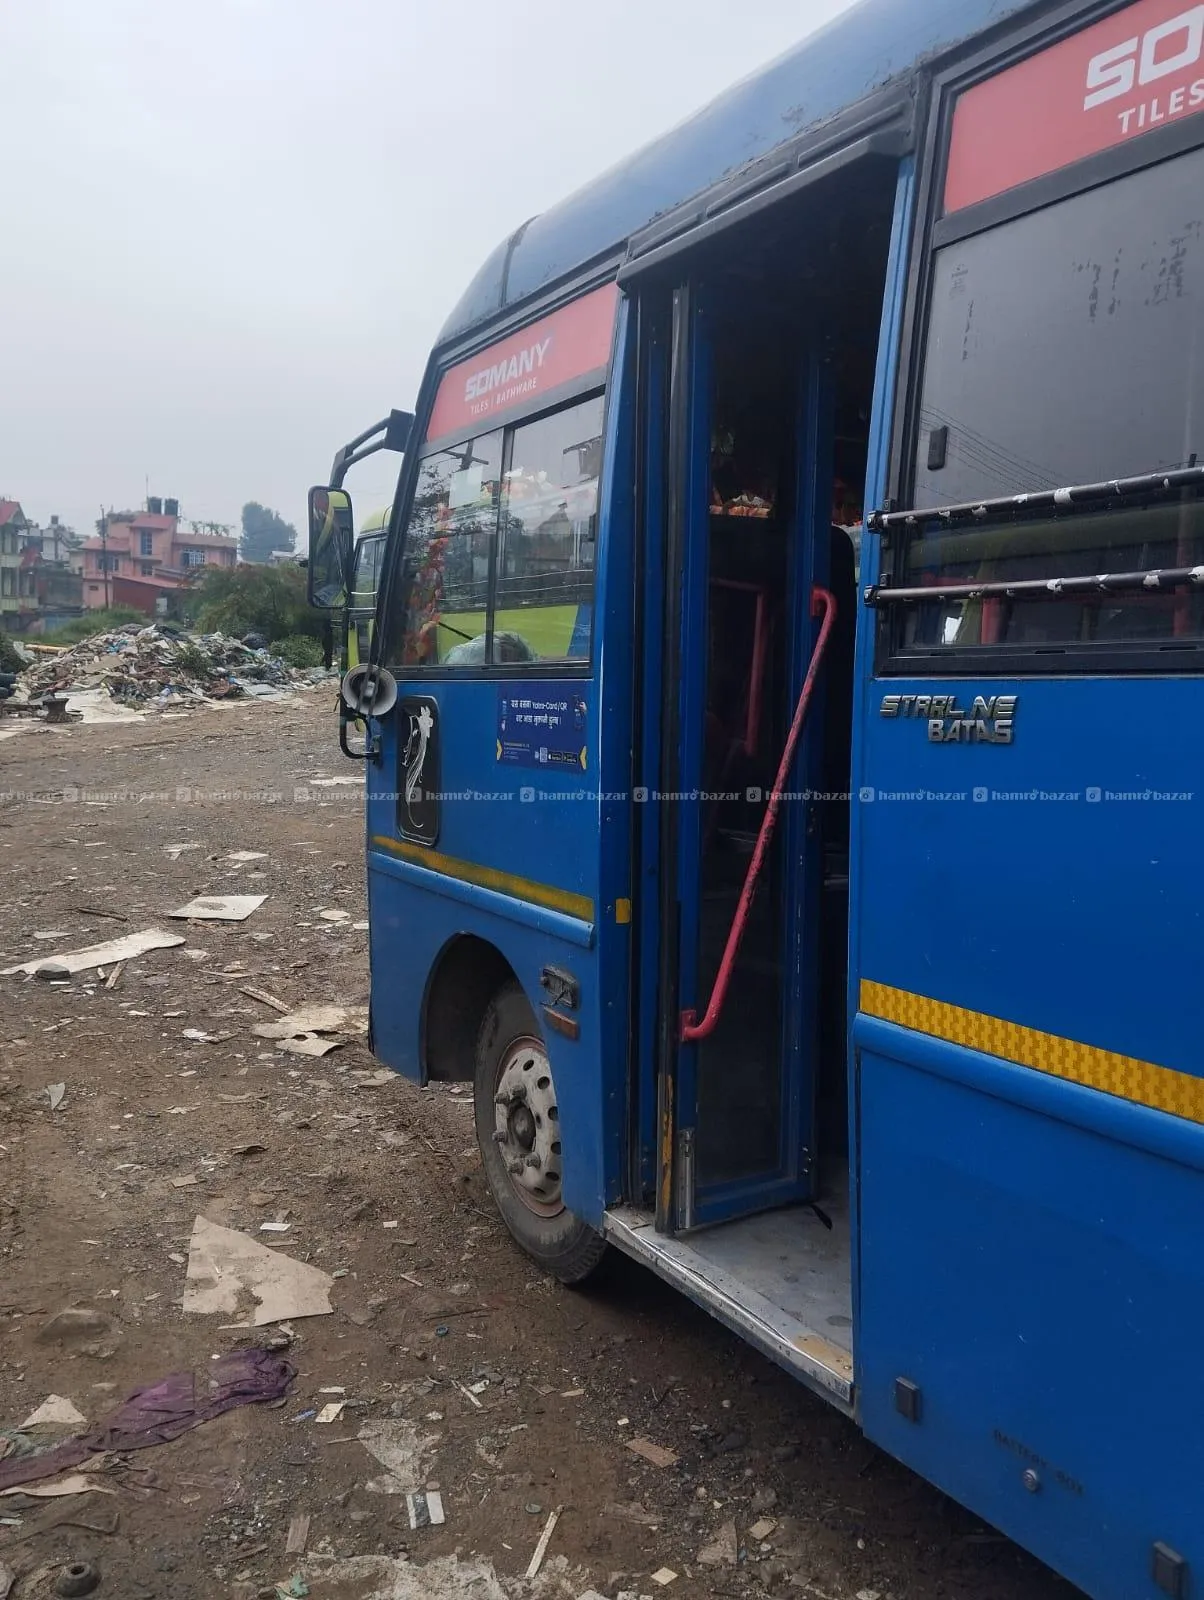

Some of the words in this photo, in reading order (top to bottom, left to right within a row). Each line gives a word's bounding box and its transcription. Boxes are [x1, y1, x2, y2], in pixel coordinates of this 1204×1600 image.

[1118, 79, 1204, 134] TILES
[464, 337, 552, 403] SOMANY
[470, 400, 489, 415] TILES
